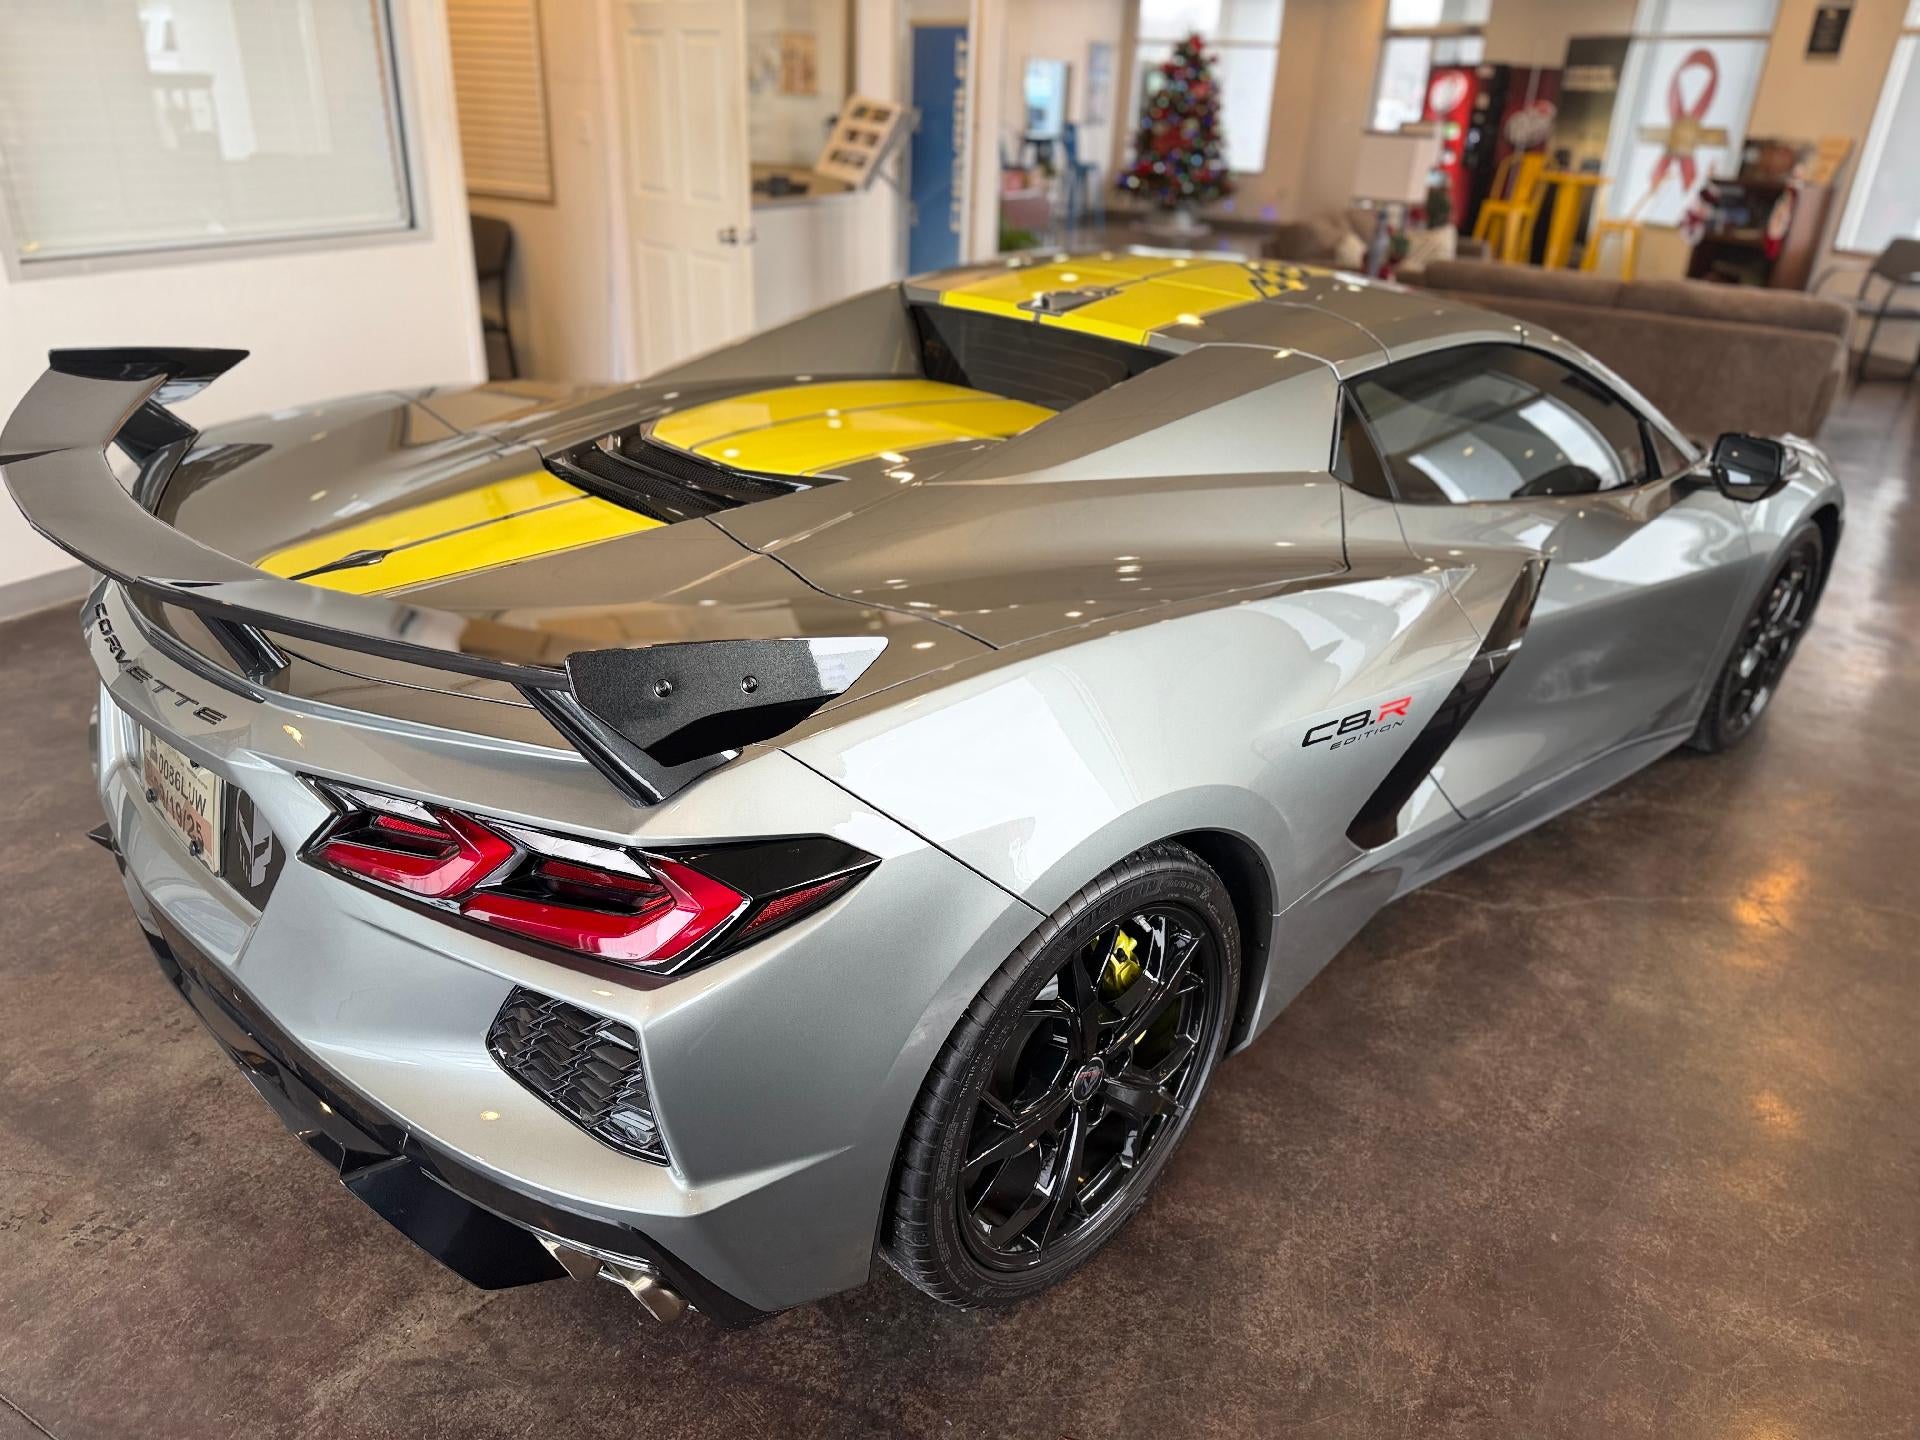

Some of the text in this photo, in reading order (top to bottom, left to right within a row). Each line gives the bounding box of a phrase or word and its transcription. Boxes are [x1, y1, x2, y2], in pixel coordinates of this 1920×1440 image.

[94, 603, 228, 726] CORVETTE
[1302, 696, 1412, 747] C8.R
[1330, 720, 1404, 750] EDITION
